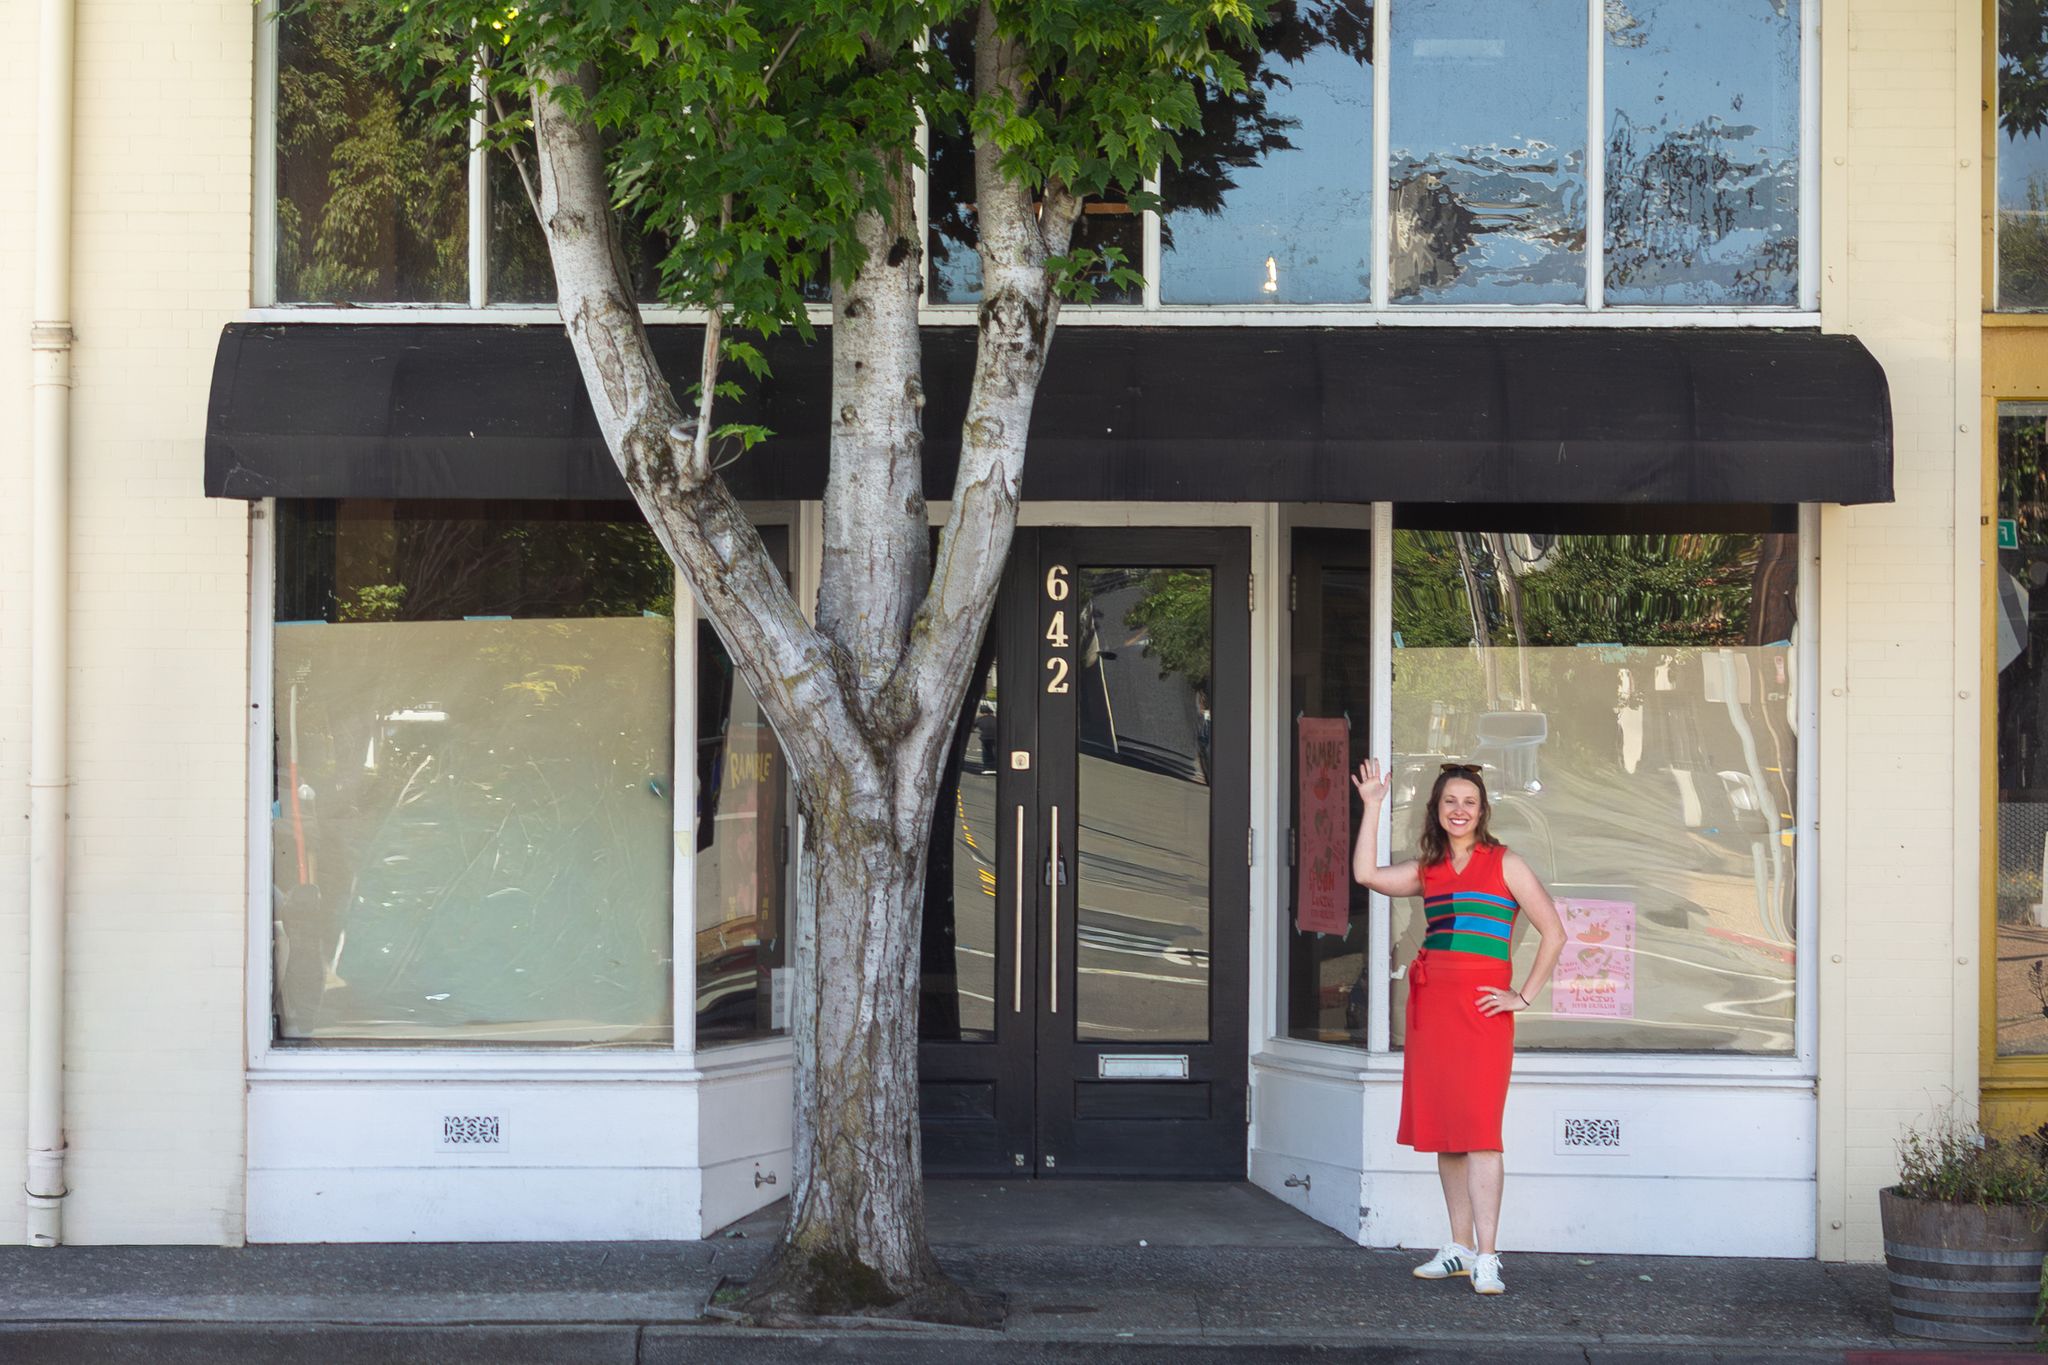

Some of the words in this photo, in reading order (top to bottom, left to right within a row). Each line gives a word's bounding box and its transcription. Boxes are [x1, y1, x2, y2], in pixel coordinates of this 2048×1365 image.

[1046, 564, 1069, 693] 642
[729, 752, 773, 789] RAMBLE
[1305, 740, 1344, 776] RAMBLE
